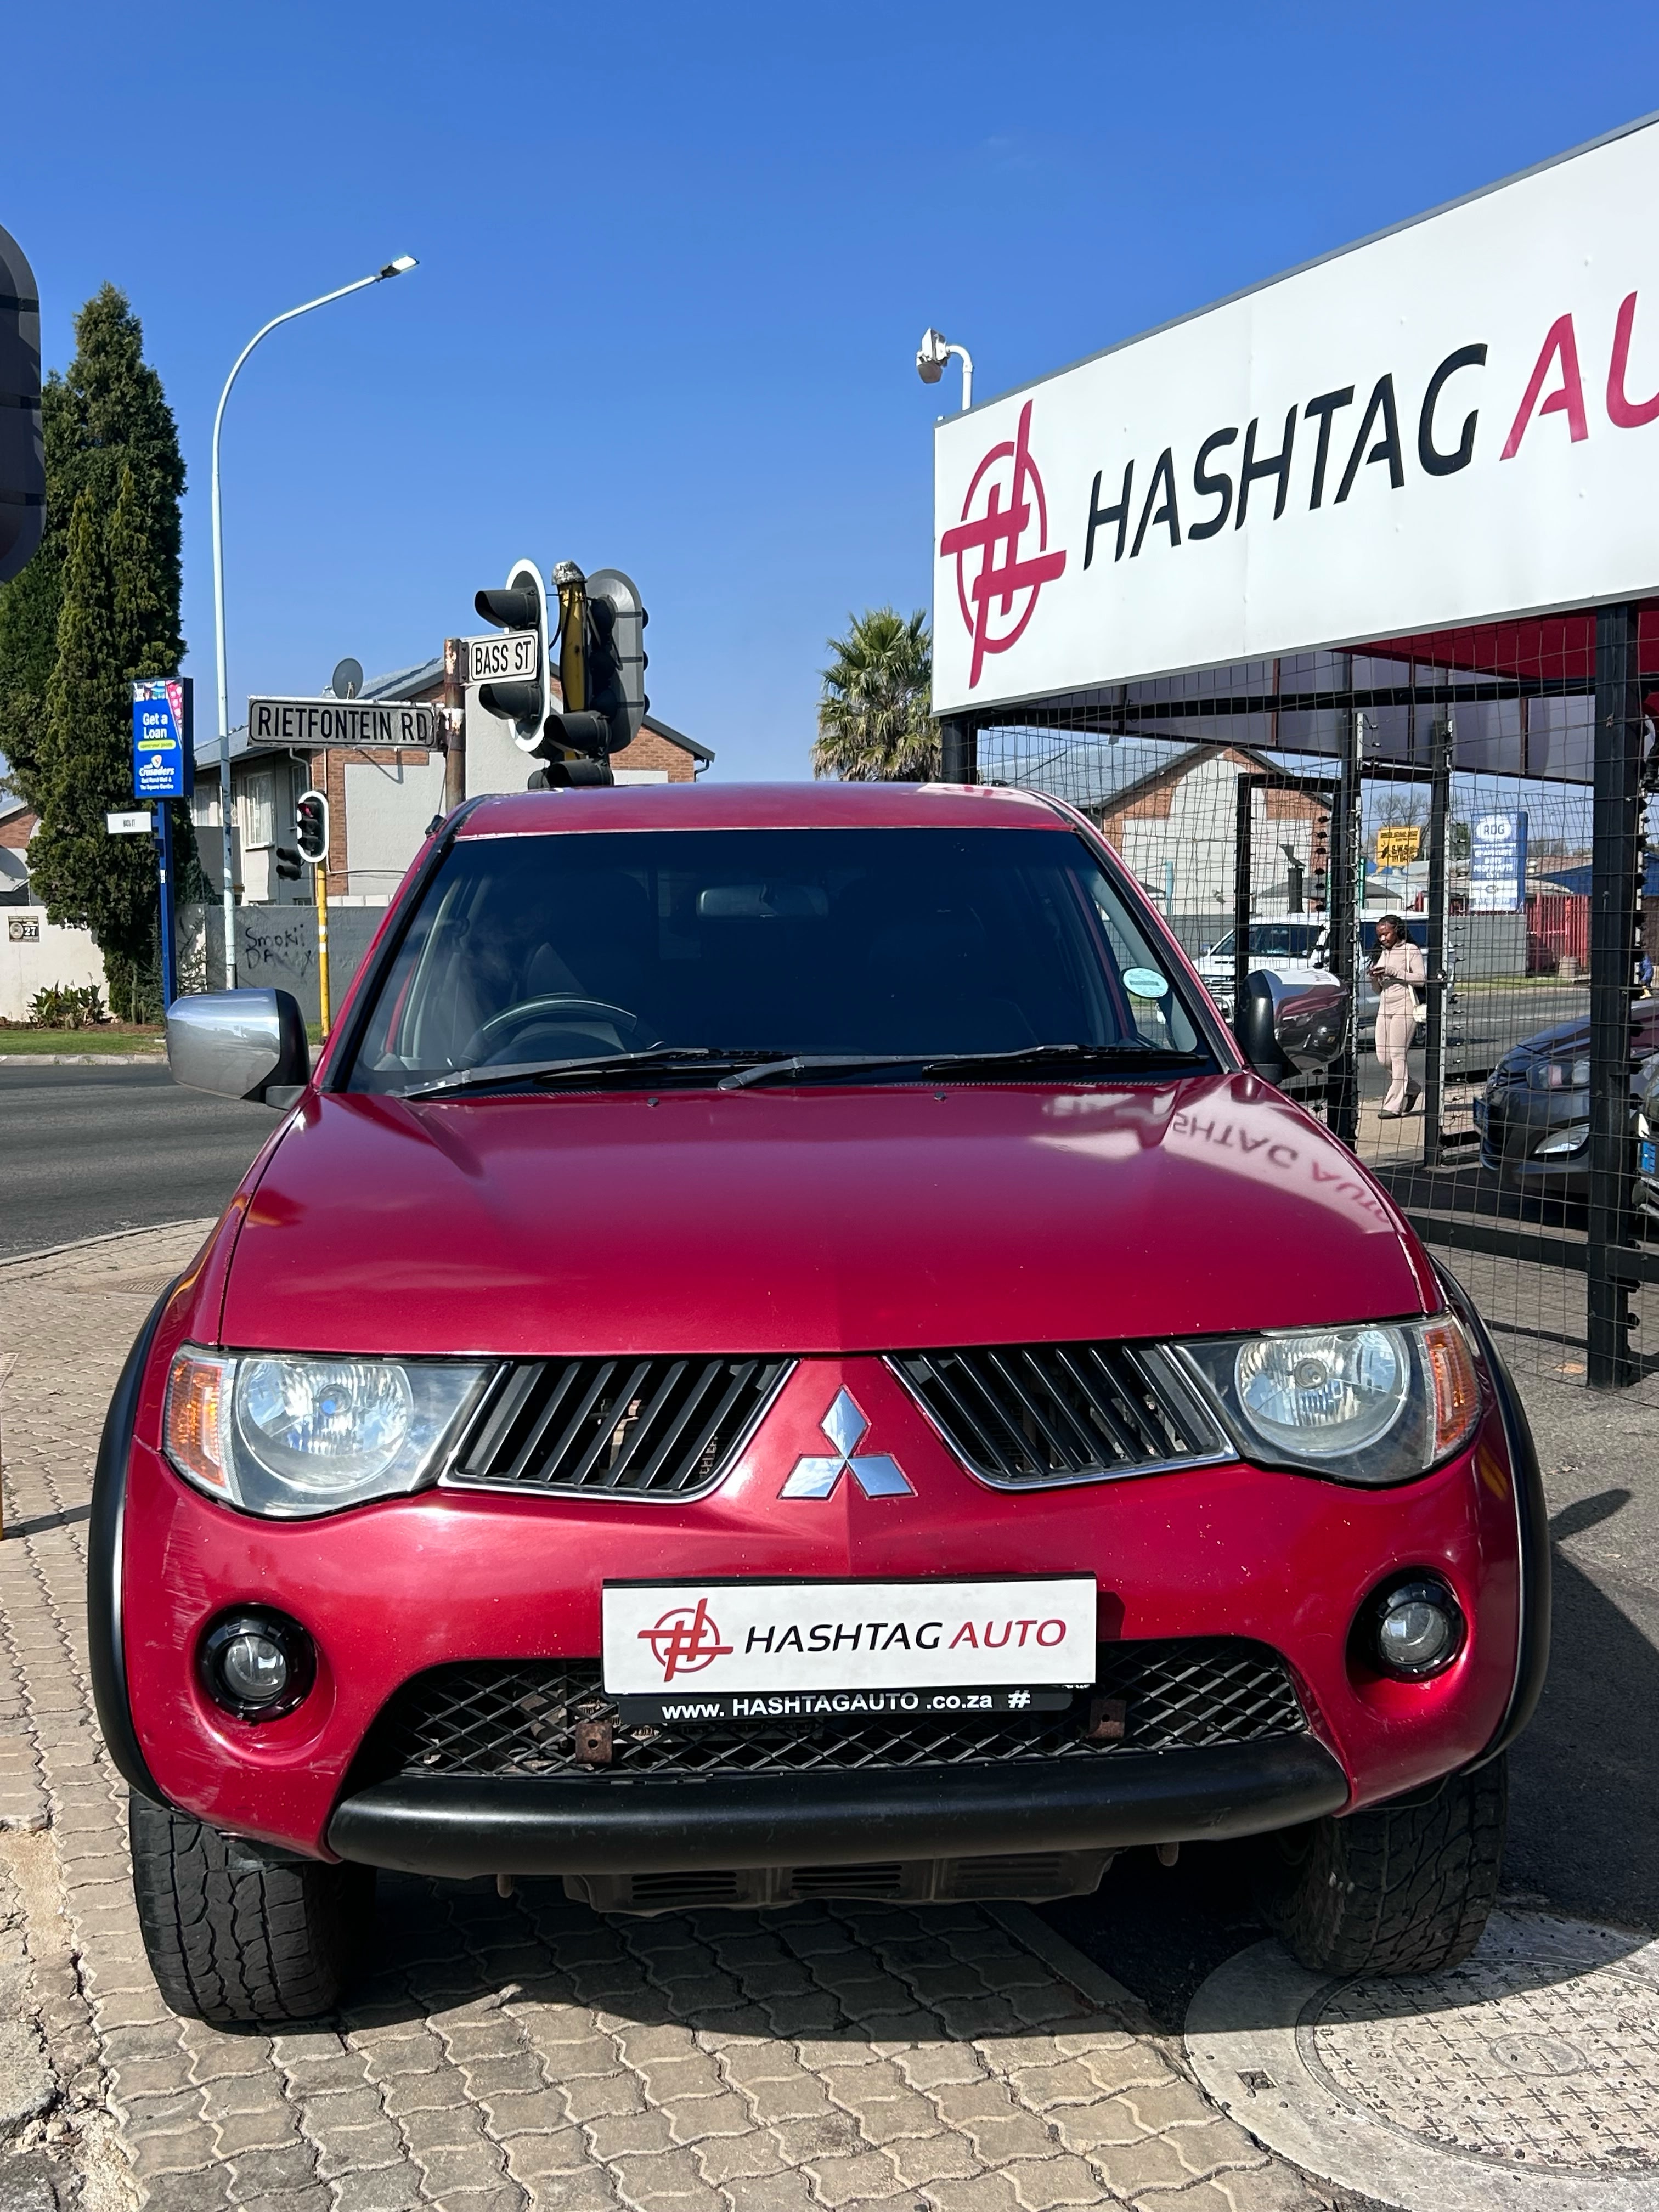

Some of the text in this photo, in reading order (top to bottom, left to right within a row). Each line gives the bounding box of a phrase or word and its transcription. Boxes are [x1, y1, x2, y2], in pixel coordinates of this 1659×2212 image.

[1084, 343, 1488, 571] HASHTAG
[475, 640, 531, 675] BASS ST
[143, 712, 168, 726] Get a
[144, 726, 167, 740] Loan
[258, 706, 428, 741] RIETFONTEIN RD
[24, 926, 36, 936] 27
[744, 1618, 1067, 1654] HASHTAG AUTO
[662, 1703, 725, 1720] www.
[732, 1692, 919, 1717] HASHTAGAUTO
[926, 1694, 993, 1709] .co.za
